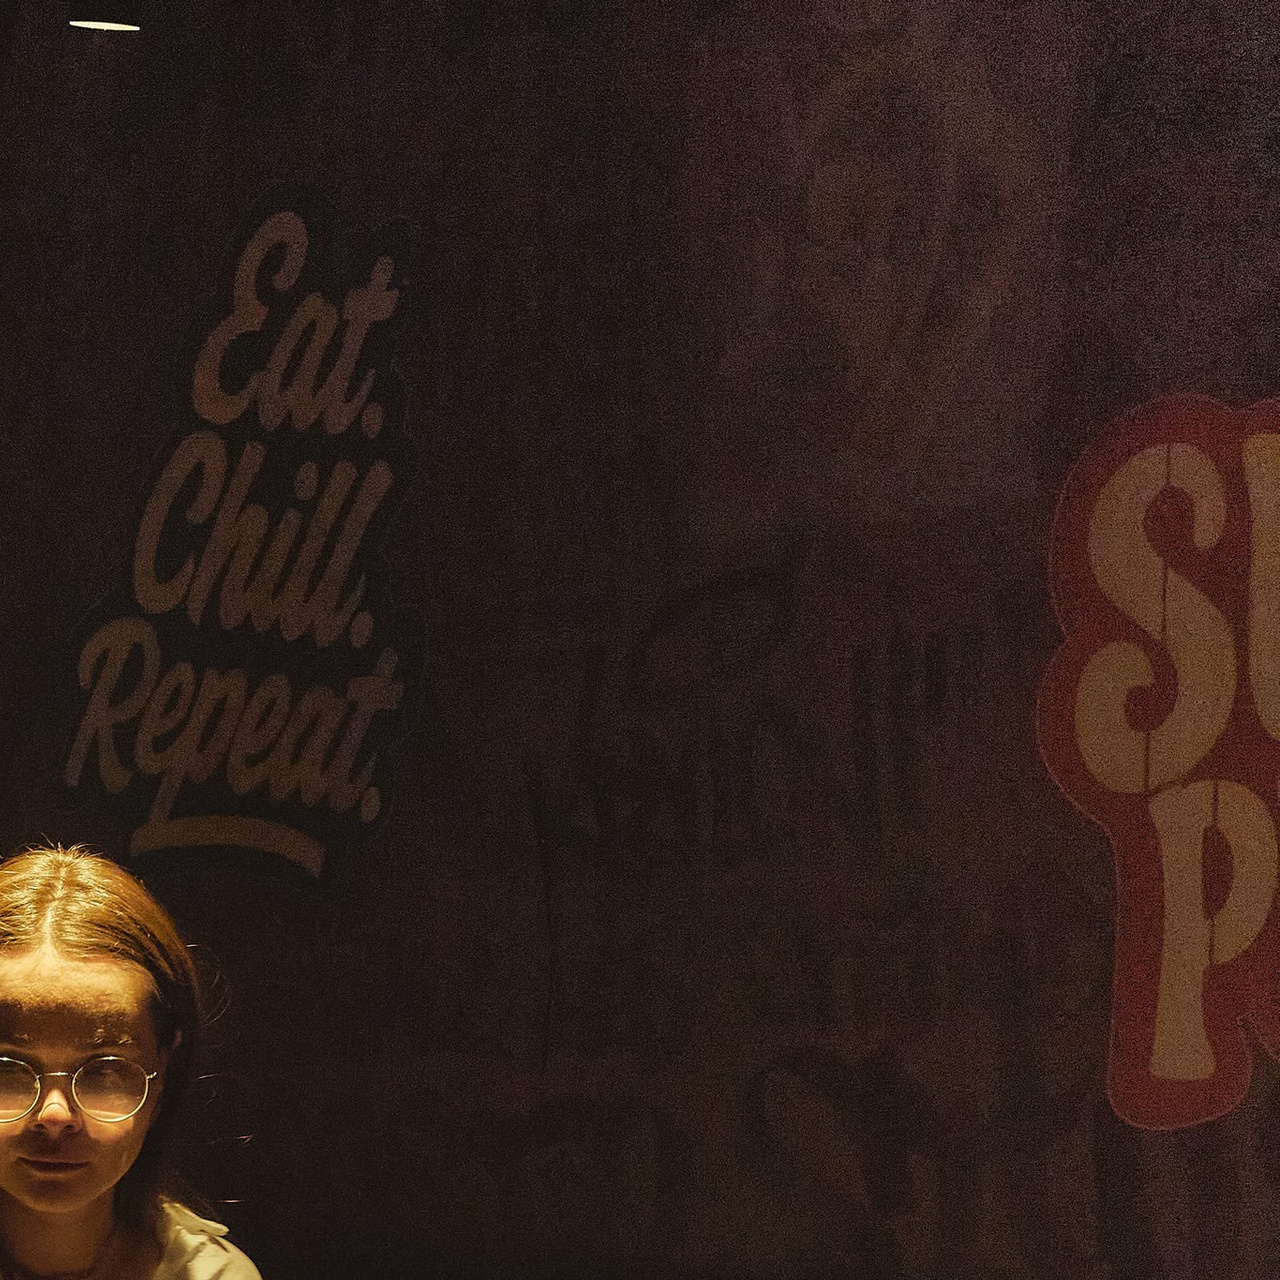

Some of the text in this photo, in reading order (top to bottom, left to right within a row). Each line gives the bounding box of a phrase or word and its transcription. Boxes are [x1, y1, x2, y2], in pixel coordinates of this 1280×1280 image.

[191, 210, 400, 440] Eat.
[132, 430, 394, 649] Chill.
[63, 616, 405, 850] Repeat.
